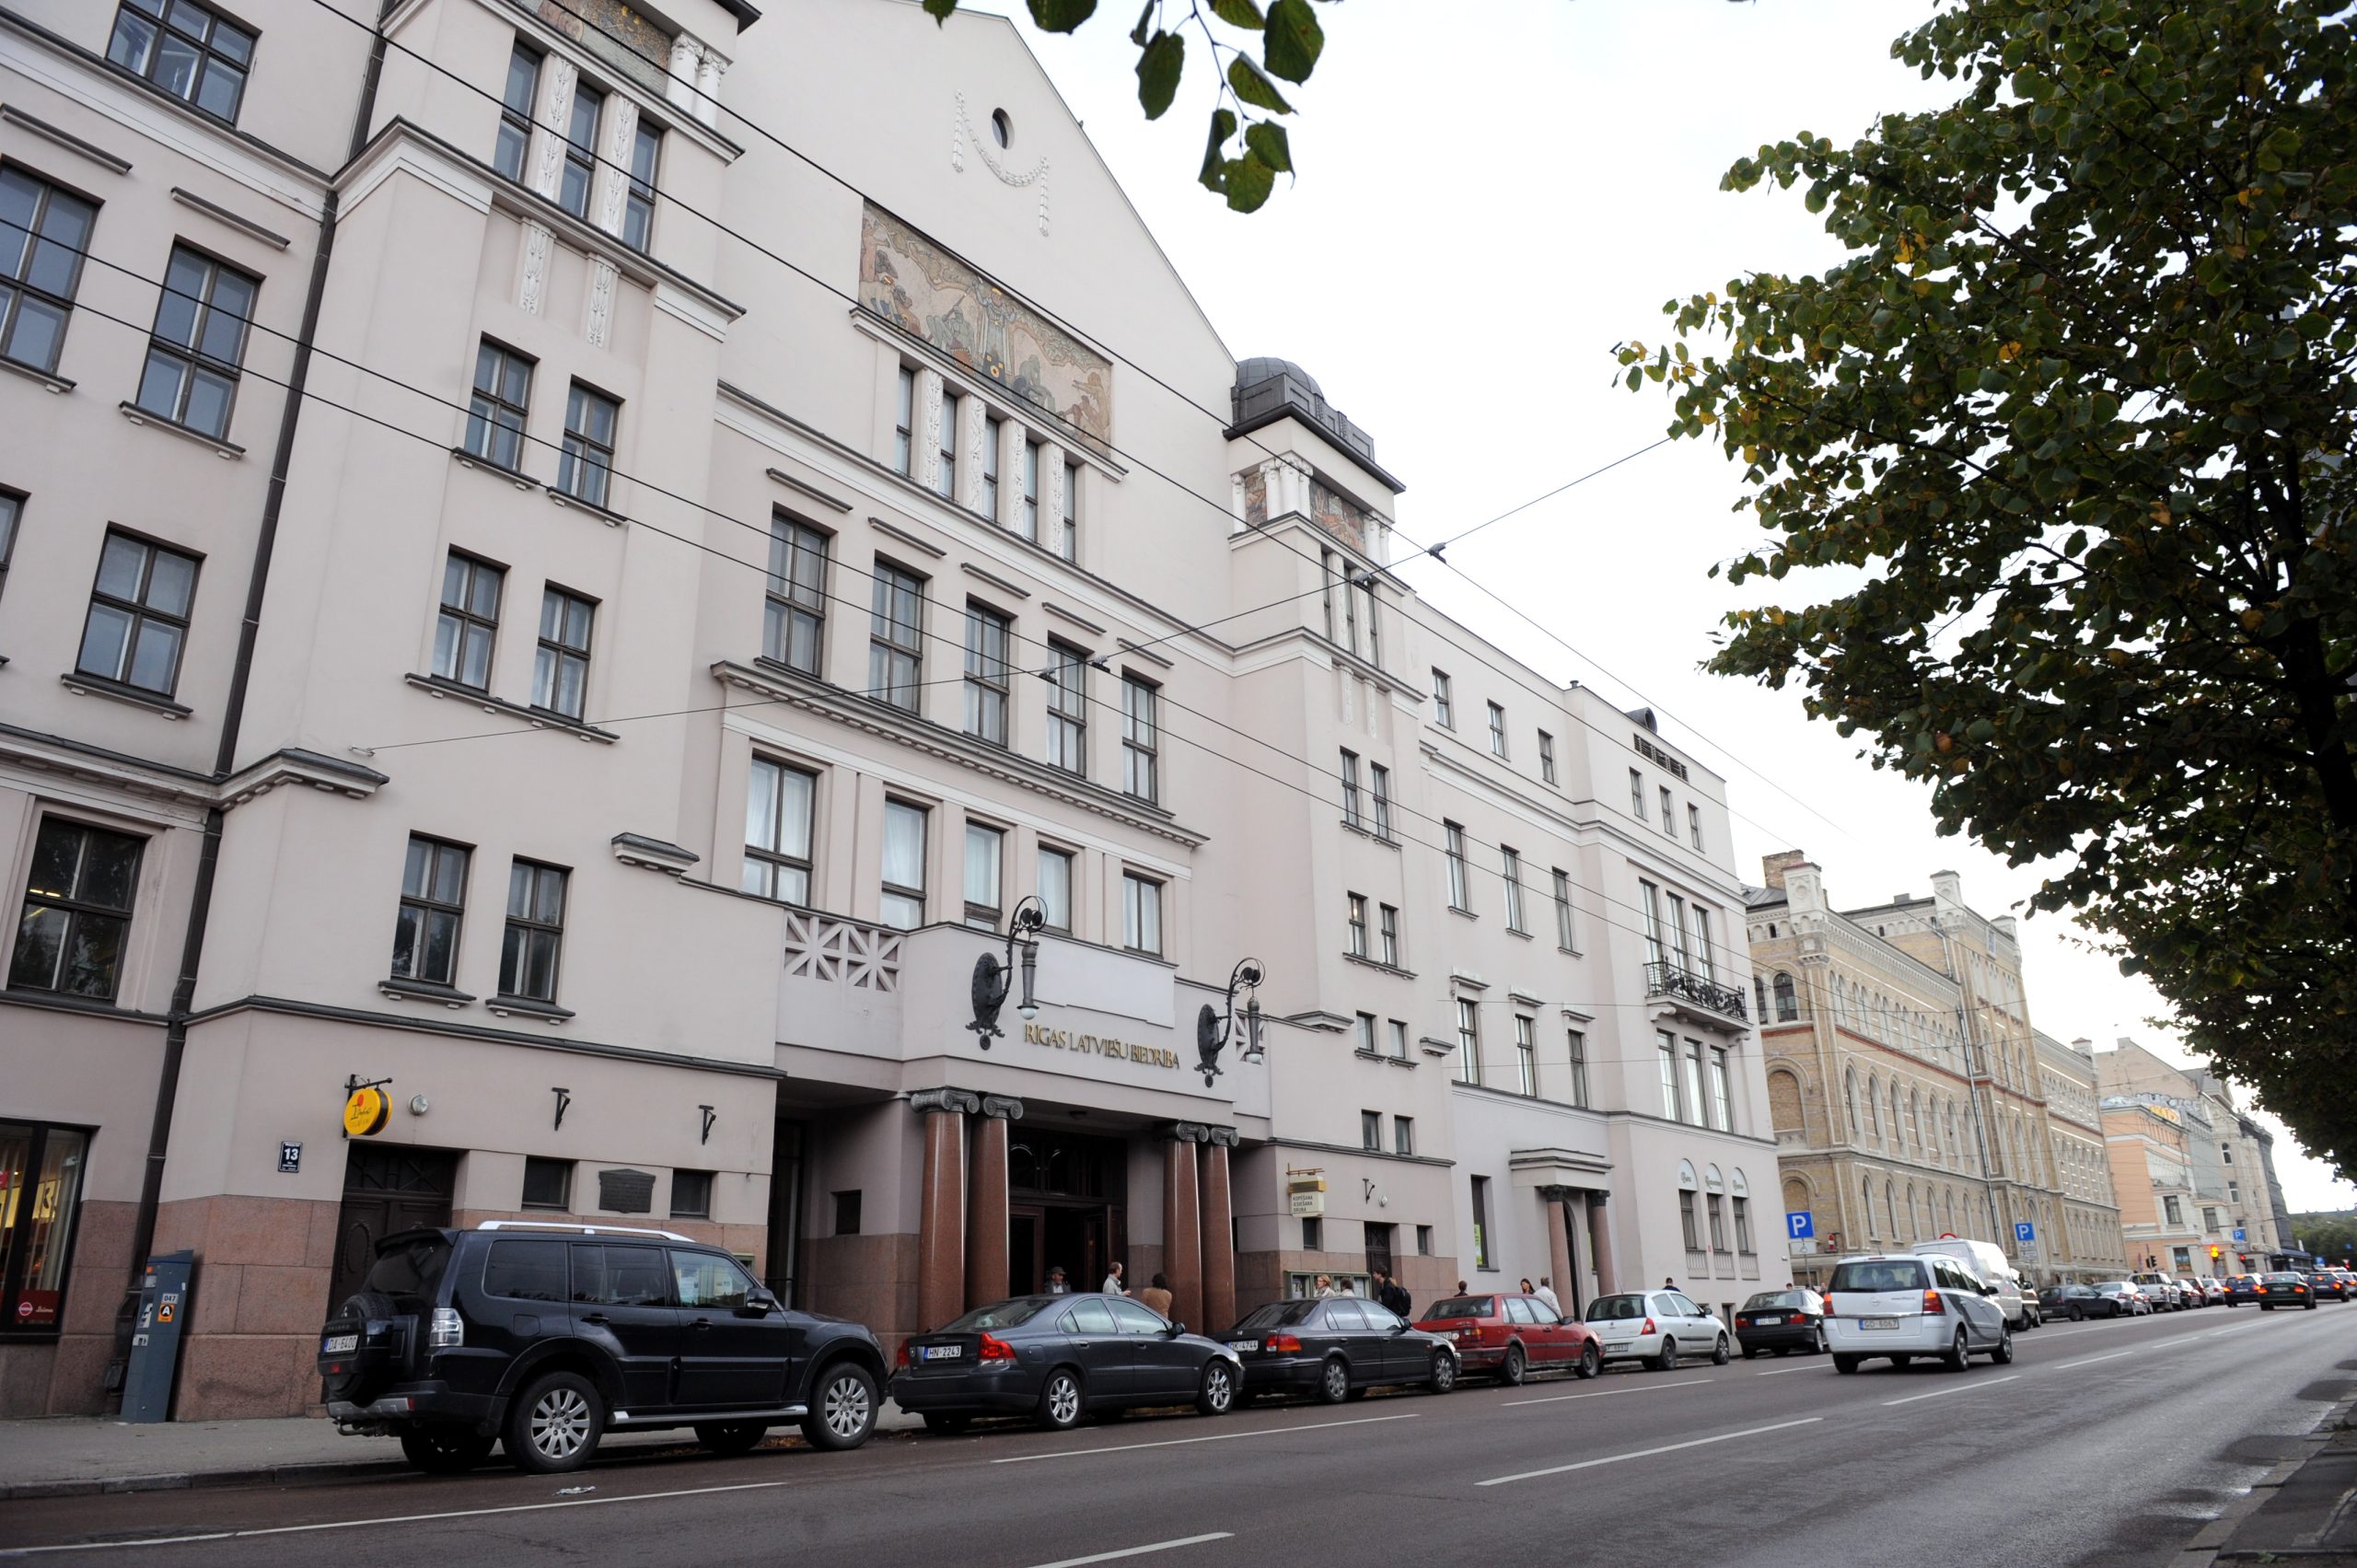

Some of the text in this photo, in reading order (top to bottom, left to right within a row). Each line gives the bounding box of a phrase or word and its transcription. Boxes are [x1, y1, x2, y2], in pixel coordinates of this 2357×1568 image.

[284, 1148, 298, 1160] 13
[1792, 1214, 1806, 1236] P
[2018, 1225, 2029, 1239] P
[162, 1306, 171, 1315] A
[328, 1336, 357, 1351] DA-6400
[929, 1345, 960, 1357] HN-2243
